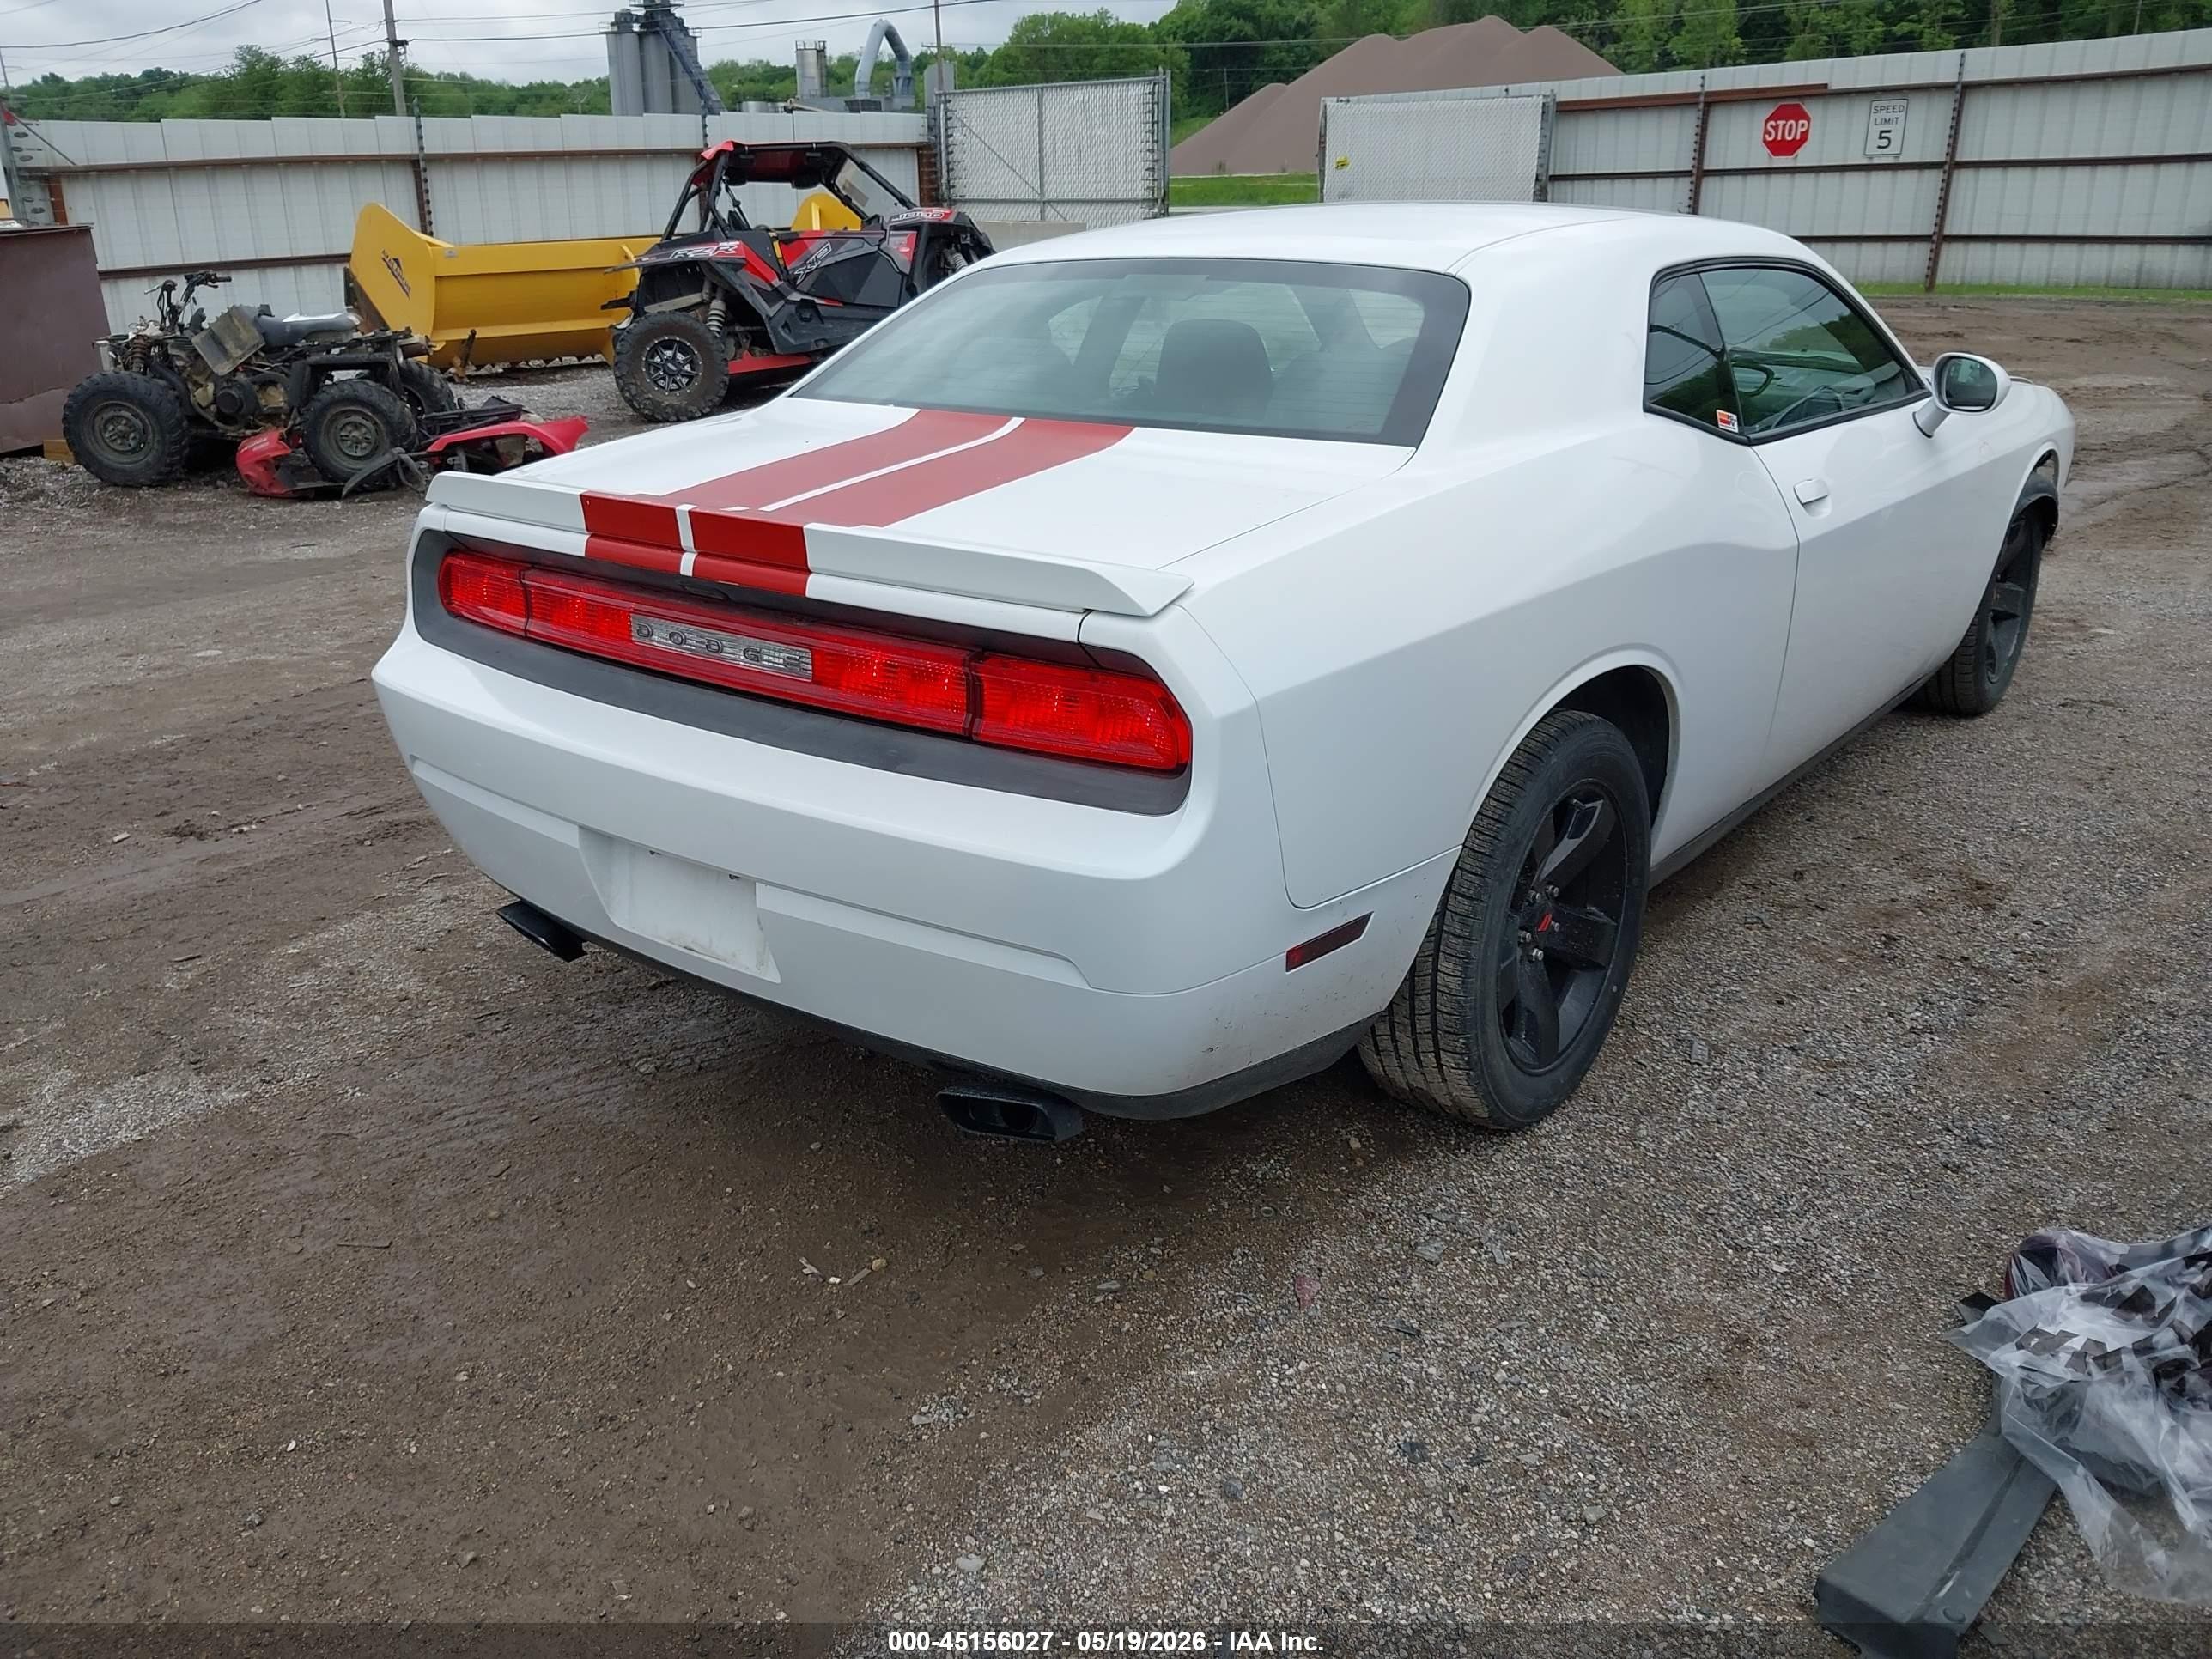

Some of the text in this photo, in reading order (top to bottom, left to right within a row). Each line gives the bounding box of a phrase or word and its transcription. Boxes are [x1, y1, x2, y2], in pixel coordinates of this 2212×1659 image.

[1873, 105, 1905, 113] SPEED
[1765, 119, 1808, 141] STOP
[1875, 117, 1899, 125] LIMIT
[1876, 129, 1893, 149] 5
[636, 623, 805, 672] DODGE
